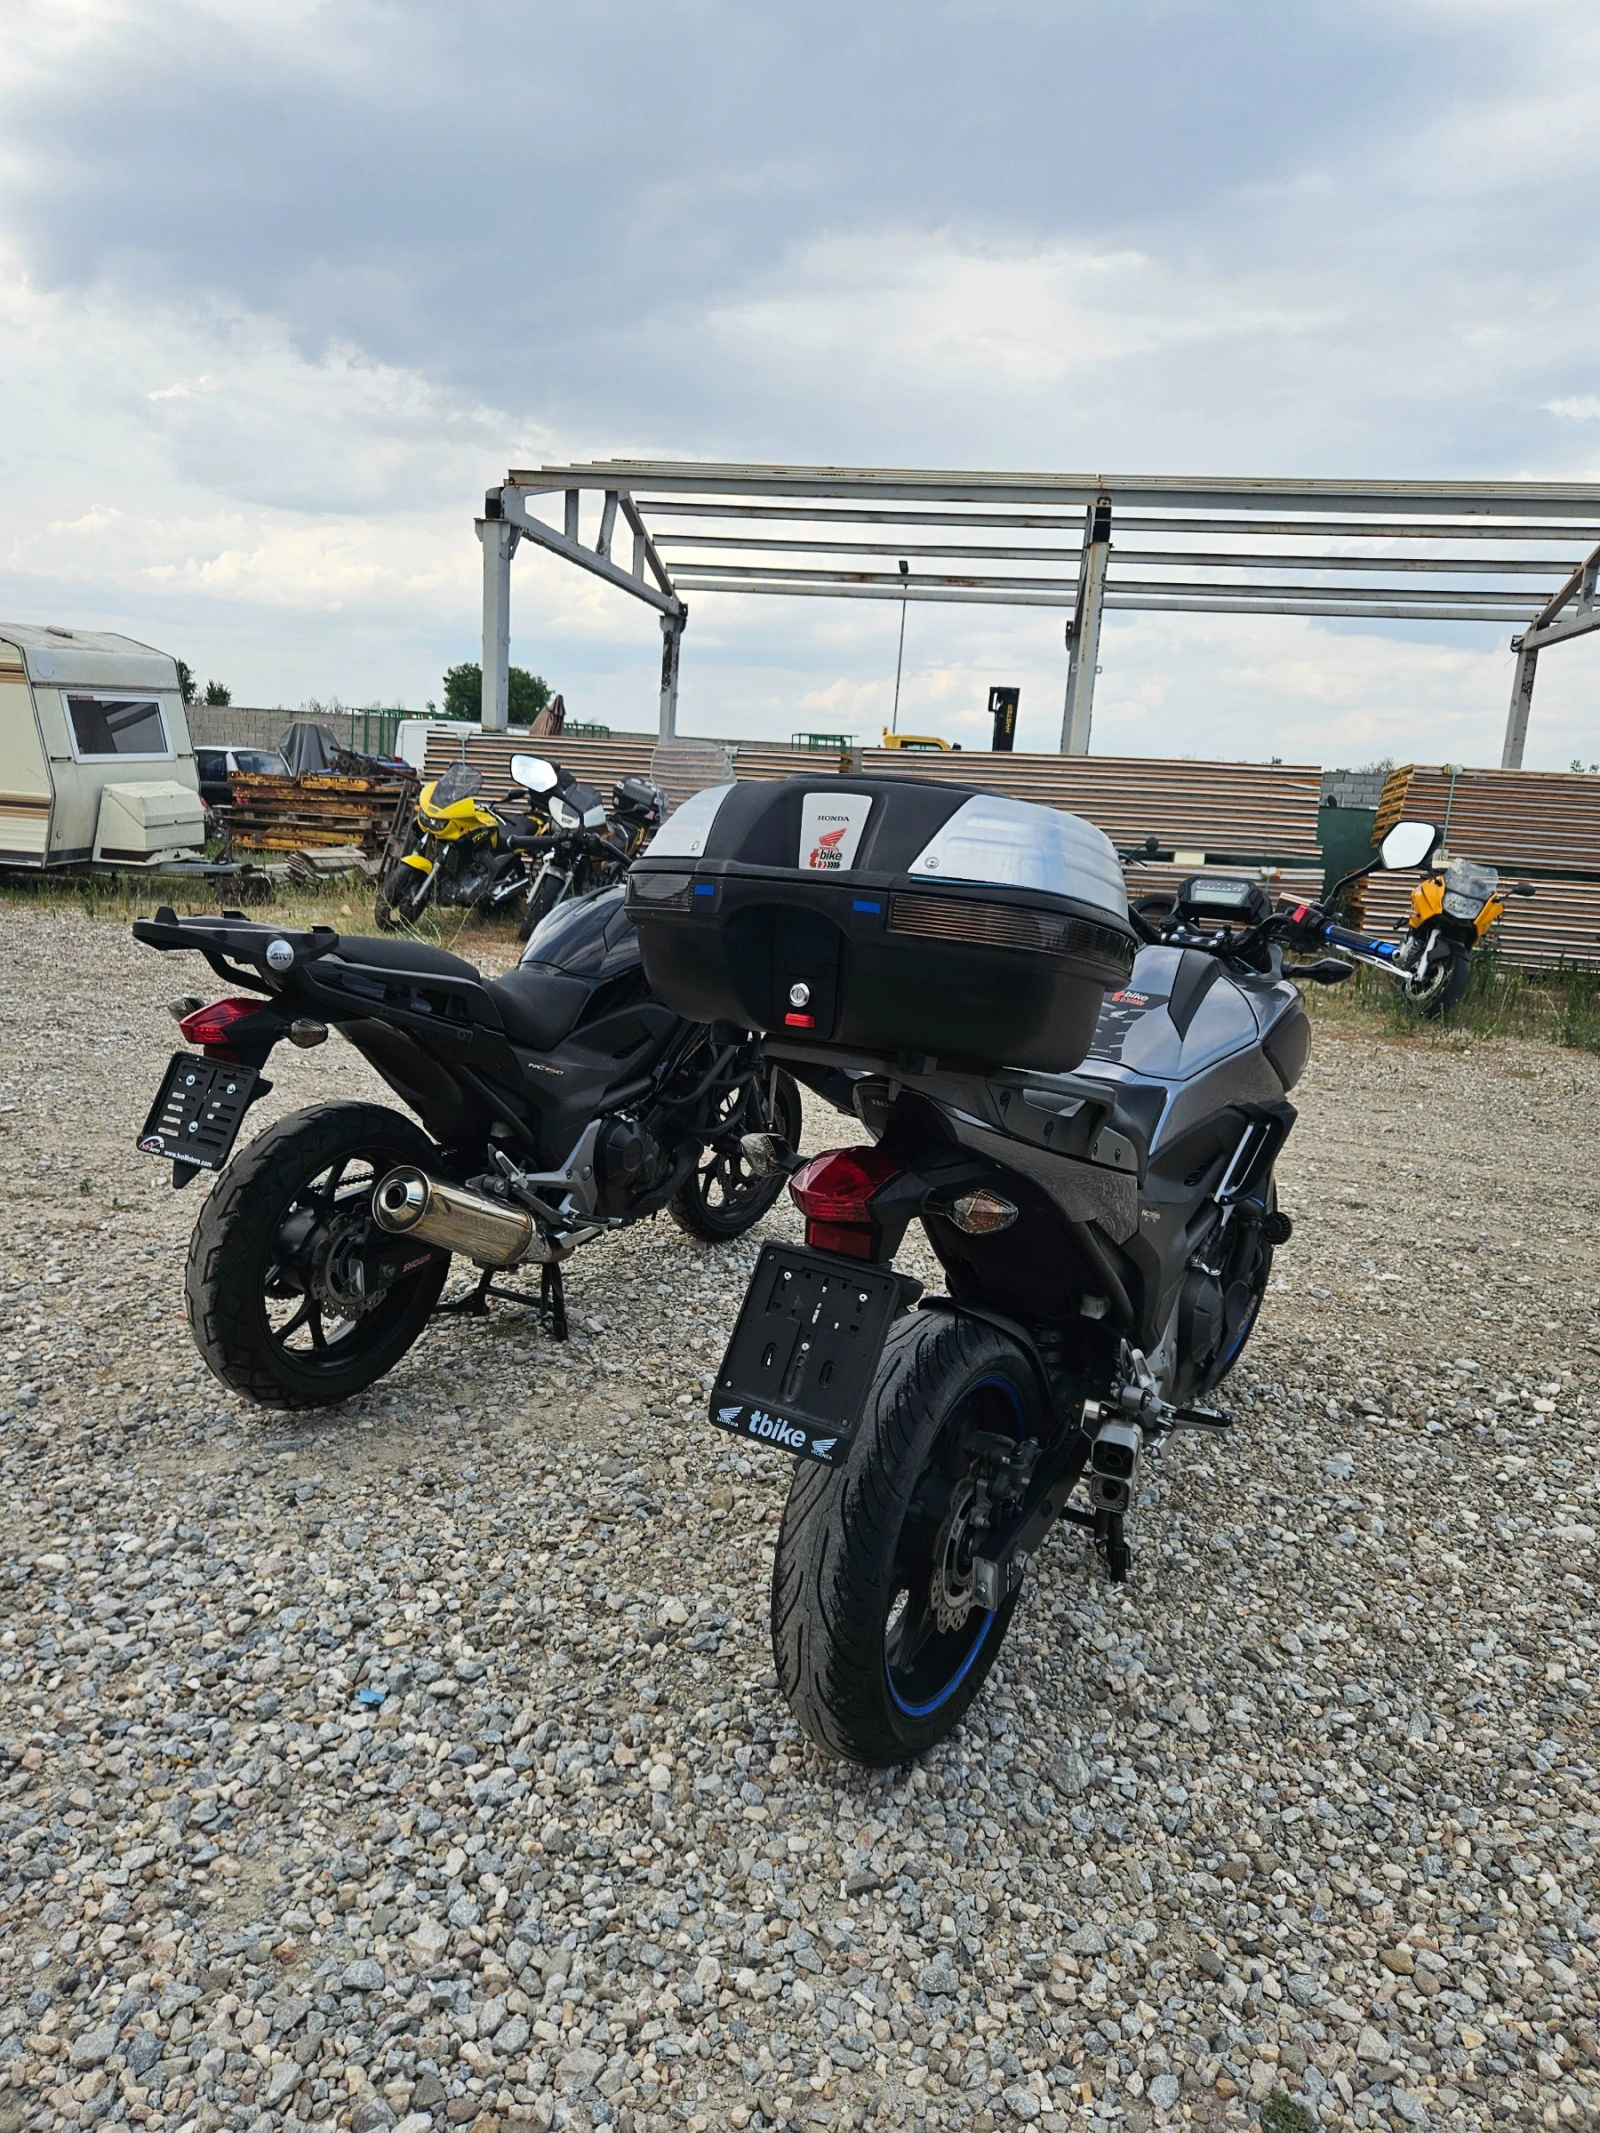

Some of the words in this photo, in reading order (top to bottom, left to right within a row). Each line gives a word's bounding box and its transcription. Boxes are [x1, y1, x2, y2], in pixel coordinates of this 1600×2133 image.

[1005, 704, 1014, 733] HYSTER
[402, 1253, 431, 1273] SHOWA
[716, 1416, 739, 1428] HONDA
[748, 1410, 806, 1448] tbike
